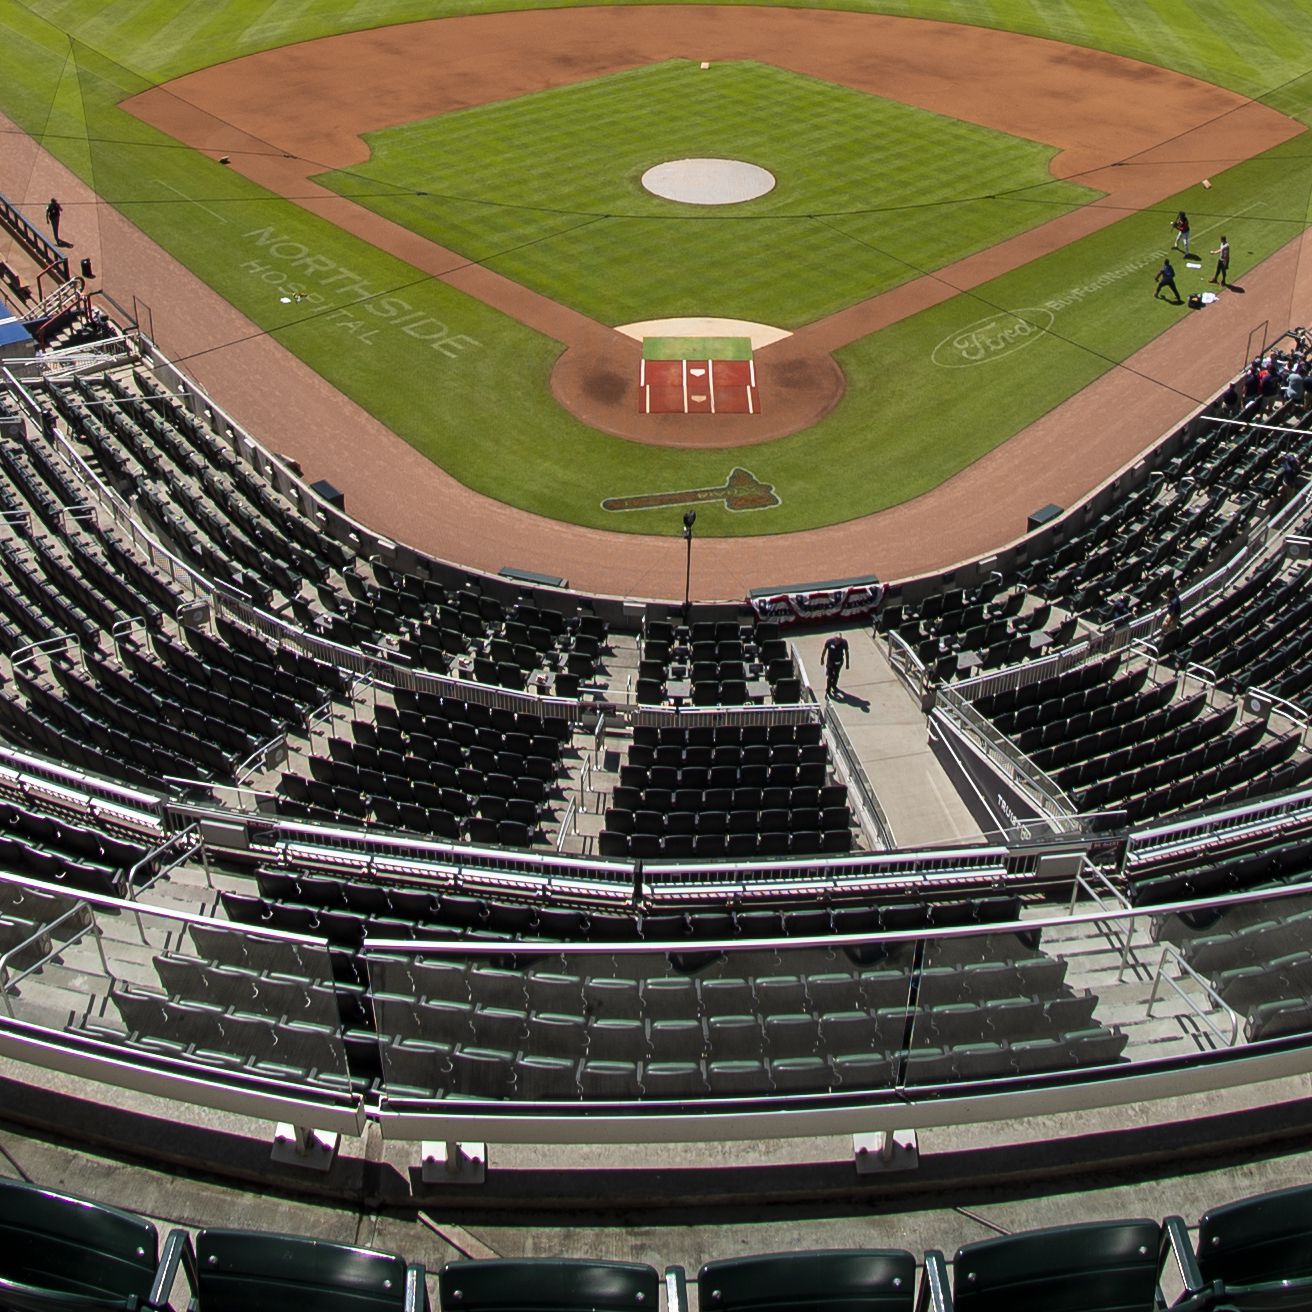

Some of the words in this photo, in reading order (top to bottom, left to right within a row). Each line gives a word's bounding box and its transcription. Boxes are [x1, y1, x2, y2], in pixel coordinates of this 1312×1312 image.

[239, 259, 381, 347] HOSPITAL
[241, 226, 483, 360] NORTHSIDE
[1046, 248, 1169, 312] BuyFordNow.com
[953, 318, 1039, 361] Ford
